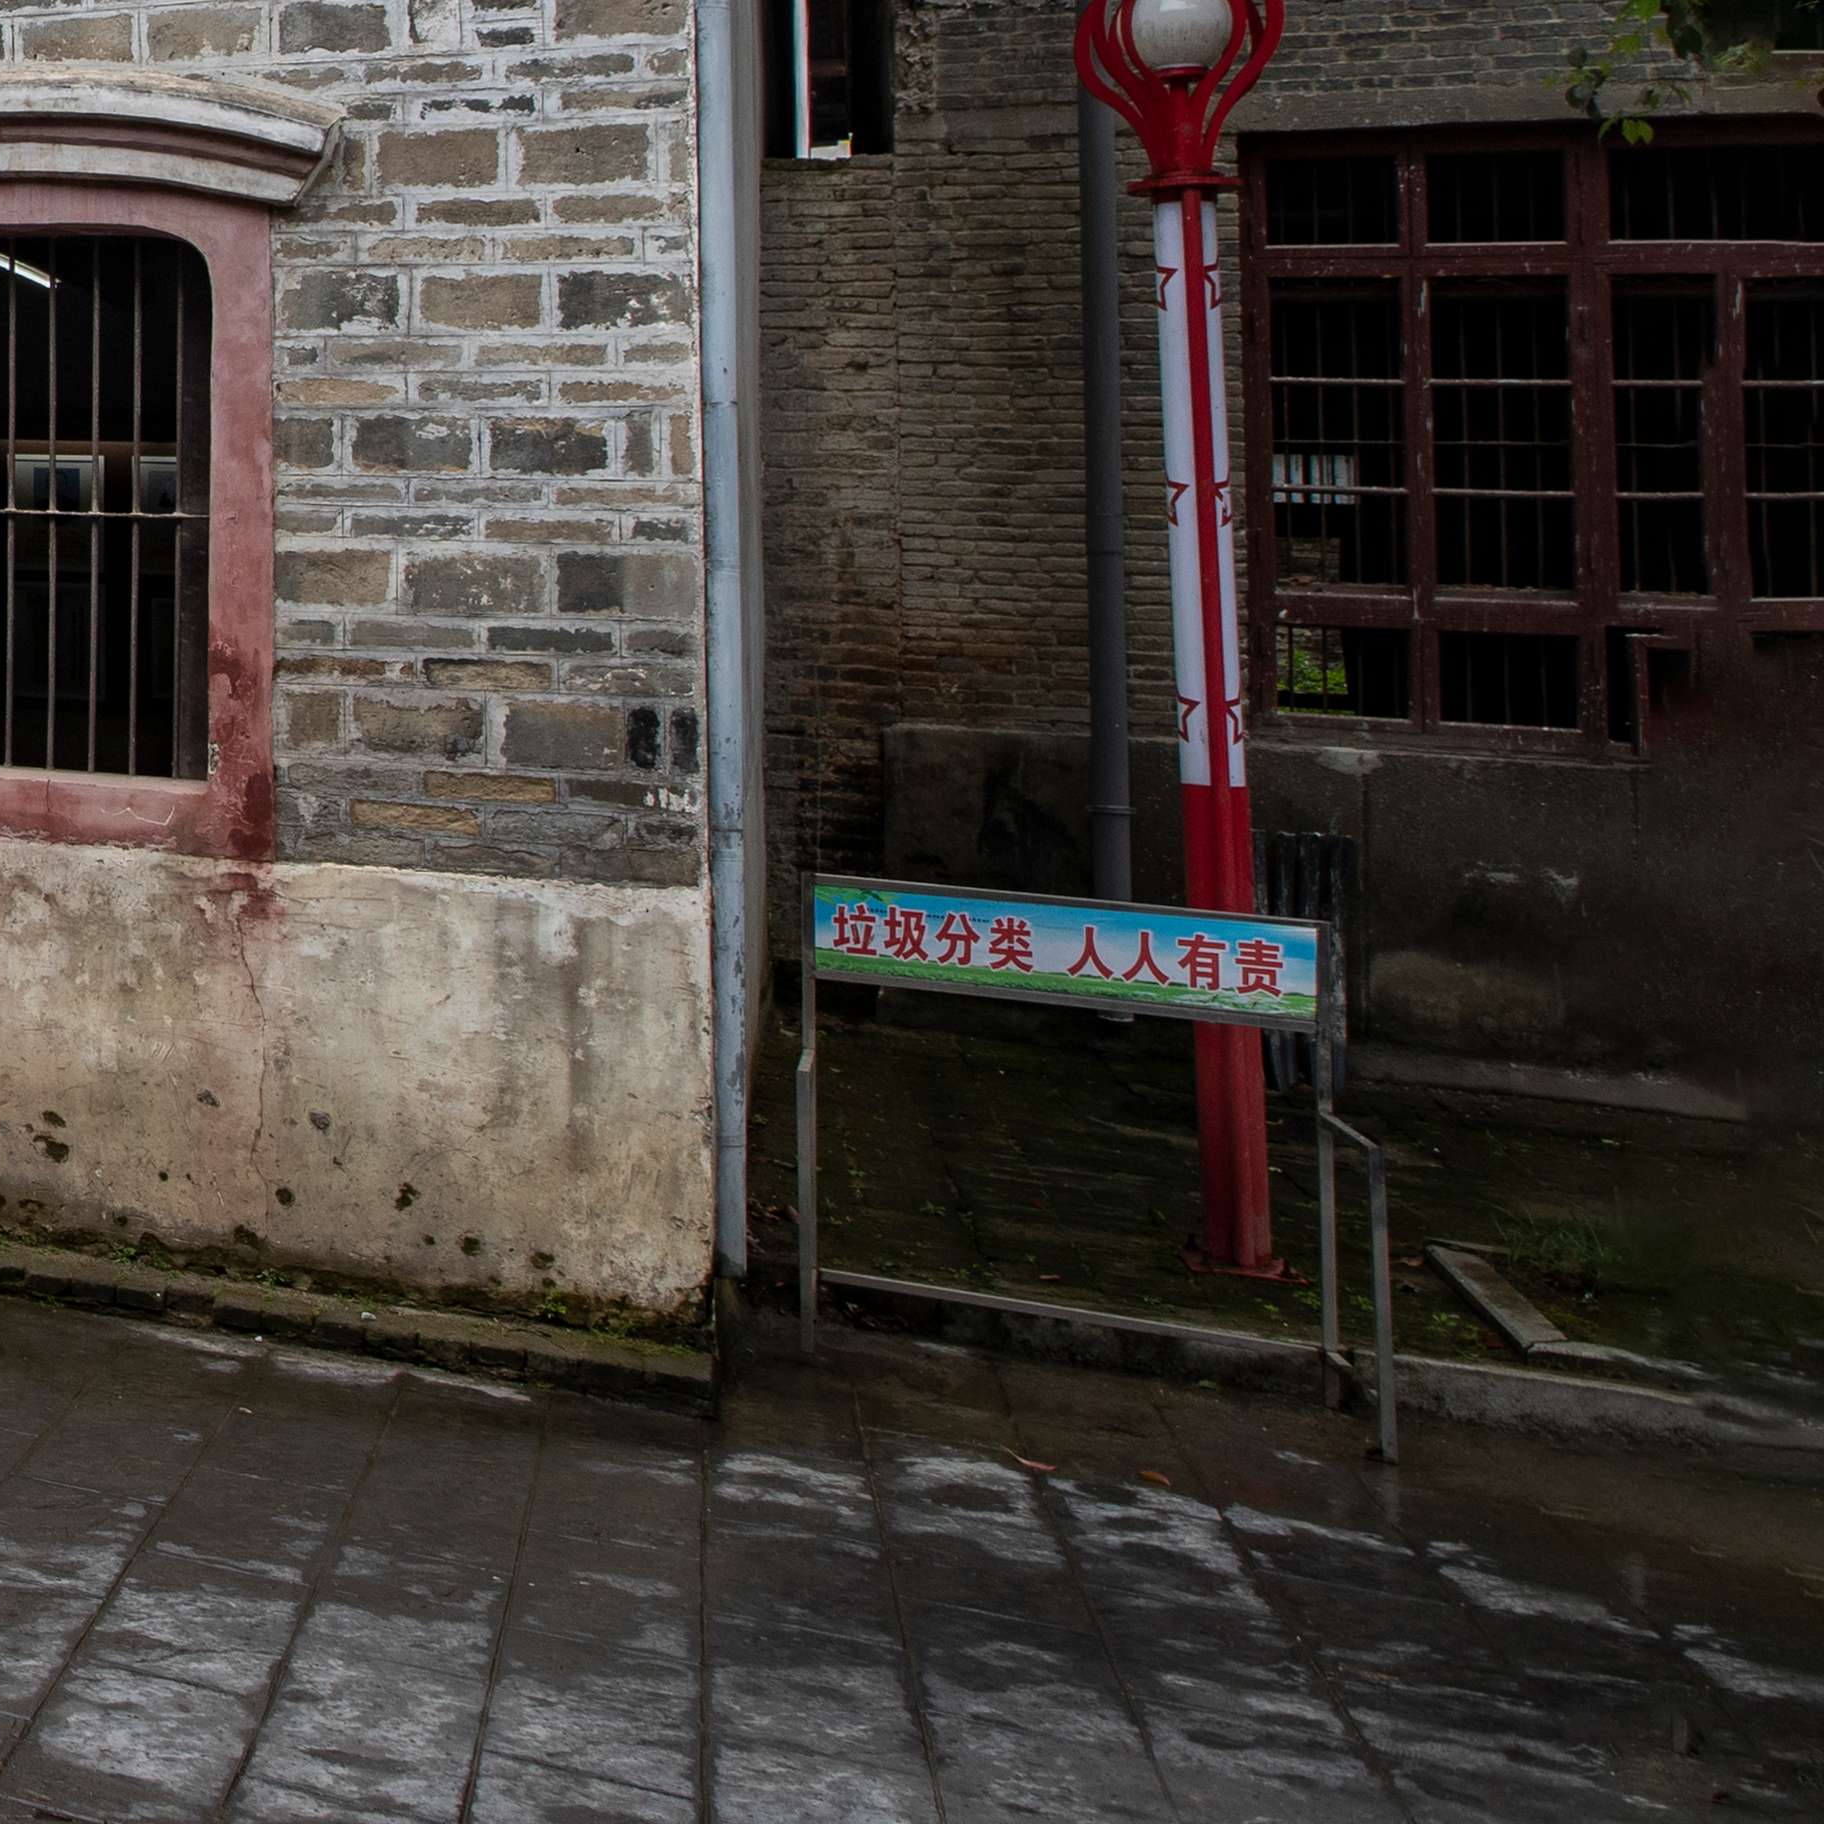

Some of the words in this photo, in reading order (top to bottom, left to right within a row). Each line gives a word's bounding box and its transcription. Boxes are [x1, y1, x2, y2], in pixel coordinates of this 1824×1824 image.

[832, 904, 1033, 972] 垃圾分类
[1067, 925, 1284, 996] 人人有责
